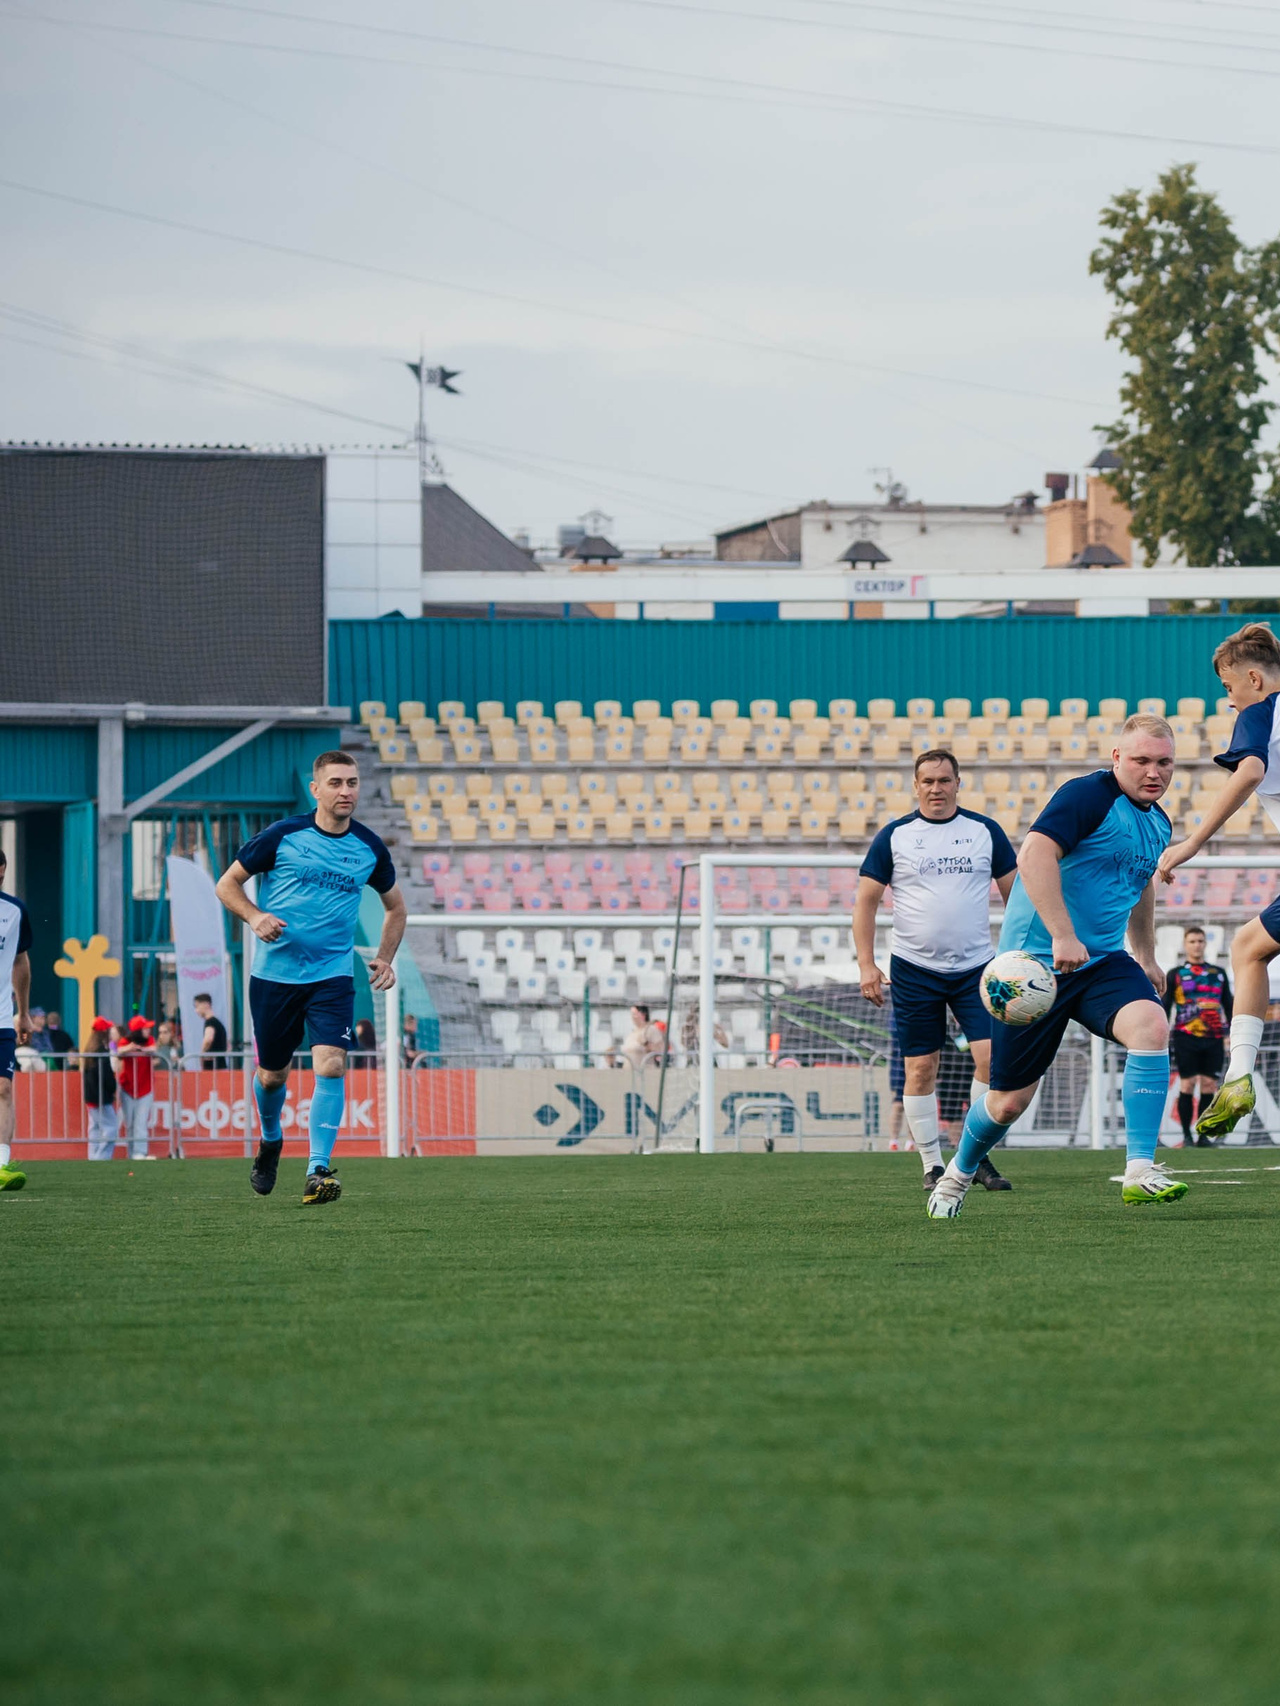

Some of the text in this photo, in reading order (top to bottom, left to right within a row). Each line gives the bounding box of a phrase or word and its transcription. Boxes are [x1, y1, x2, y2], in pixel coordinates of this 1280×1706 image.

[854, 575, 925, 597] СЕКТОР Г
[147, 1091, 258, 1139] льфа
